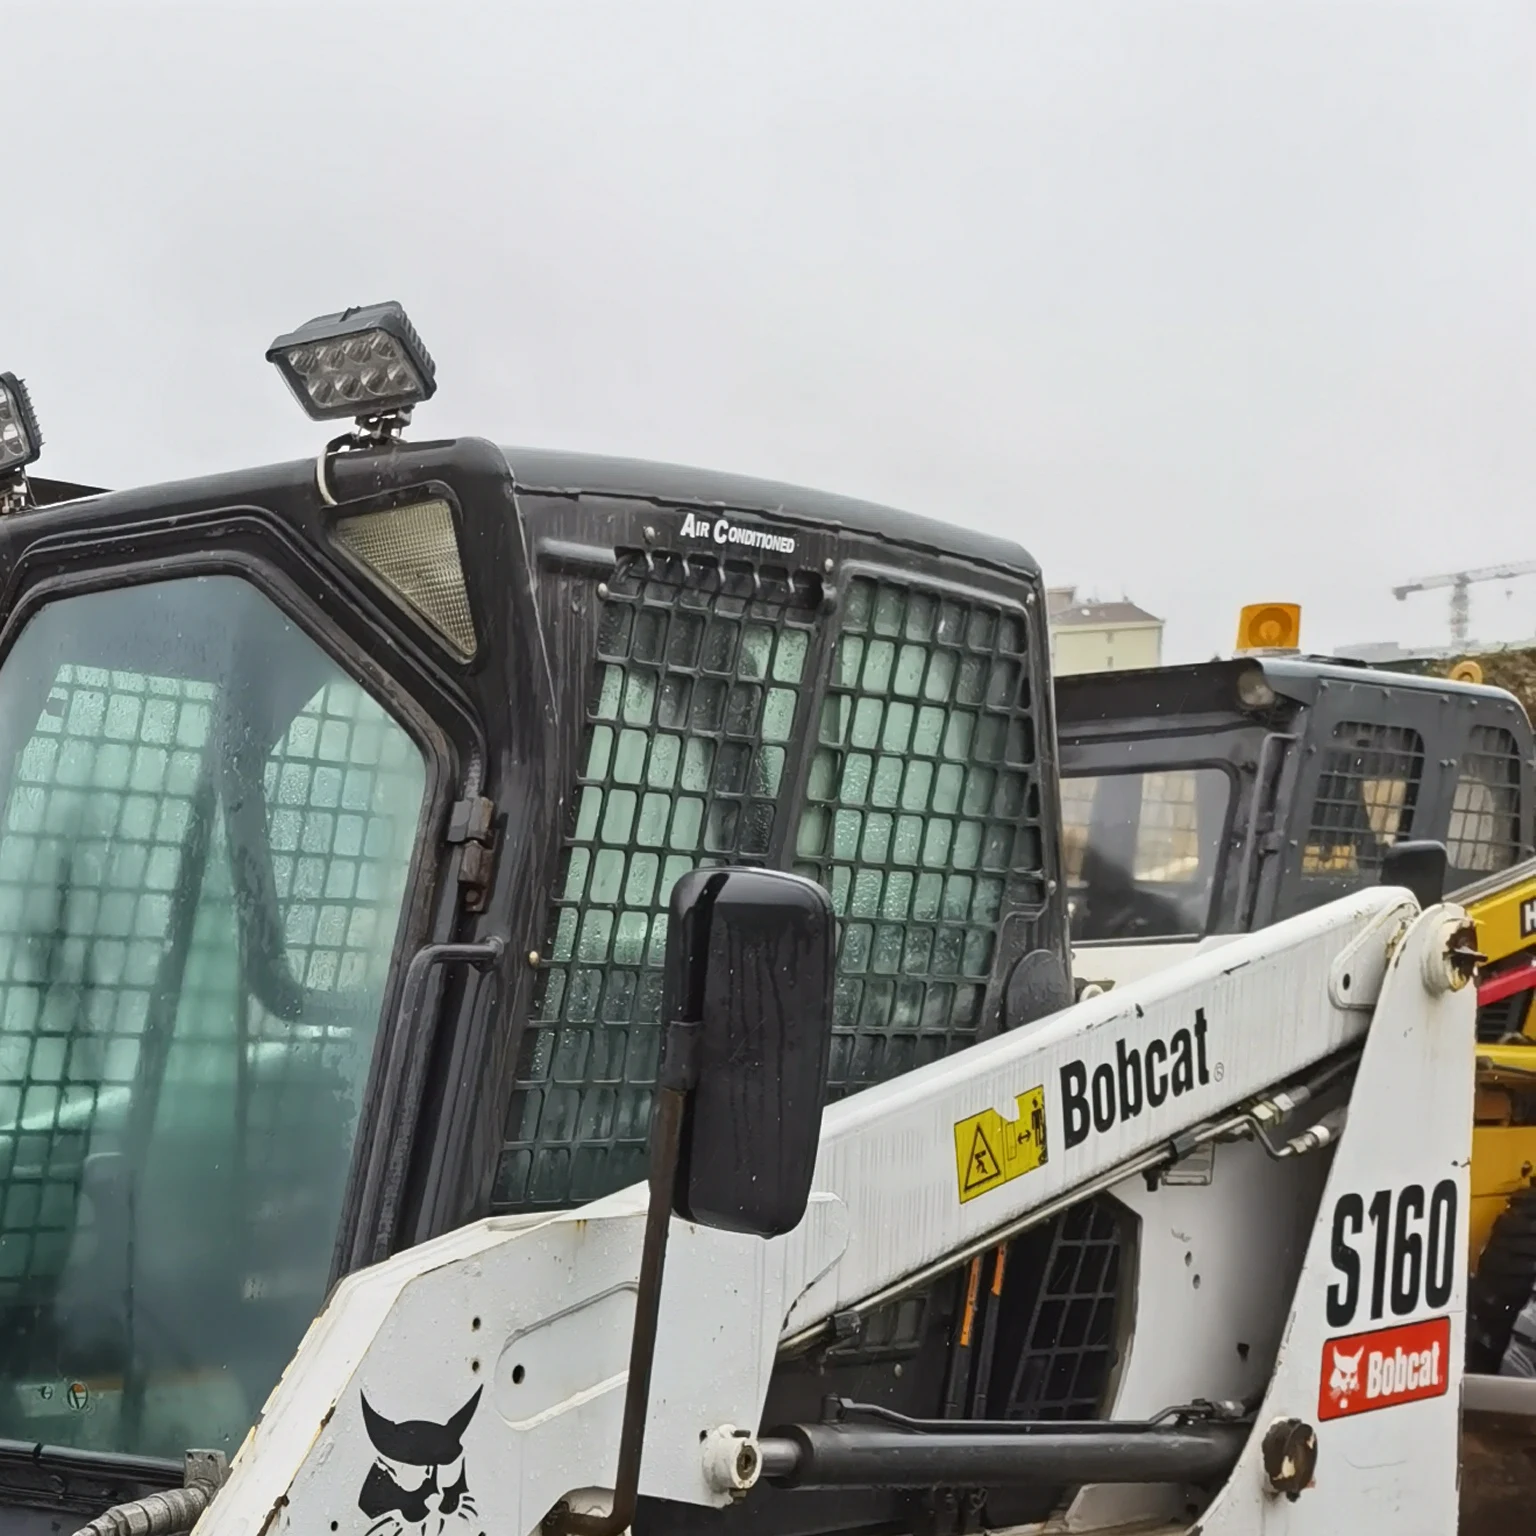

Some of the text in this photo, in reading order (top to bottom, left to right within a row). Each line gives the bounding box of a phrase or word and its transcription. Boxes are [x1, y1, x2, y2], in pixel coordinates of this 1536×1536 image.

[1060, 1007, 1210, 1150] Bobcat
[1326, 1179, 1457, 1328] S160
[1366, 1341, 1440, 1399] Bobcat
